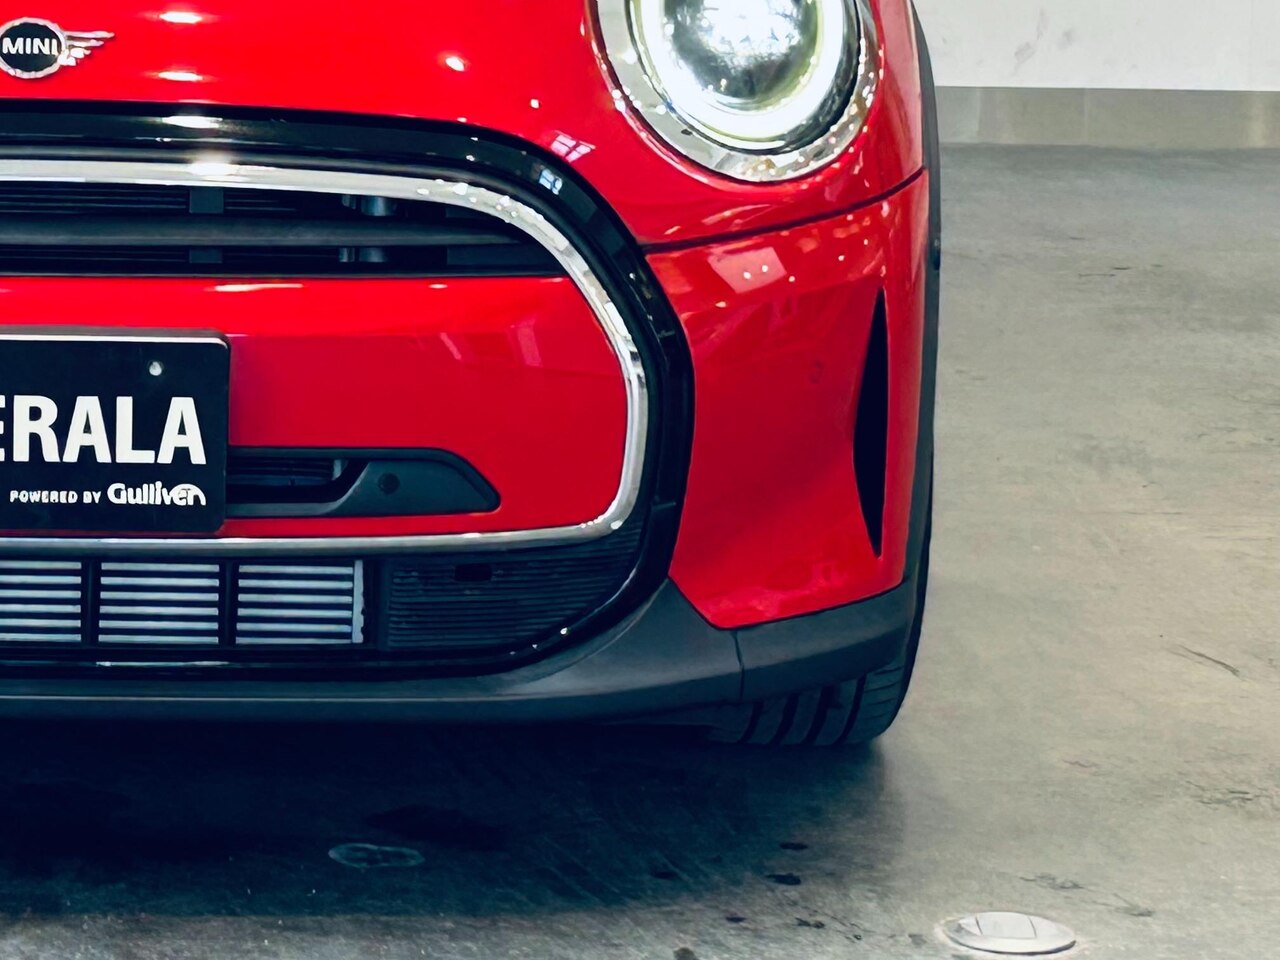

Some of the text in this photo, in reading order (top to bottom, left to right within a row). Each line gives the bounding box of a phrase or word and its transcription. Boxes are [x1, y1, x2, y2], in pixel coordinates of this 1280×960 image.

[1, 37, 59, 56] MINI
[9, 490, 79, 504] POWERED
[82, 490, 102, 504] BY
